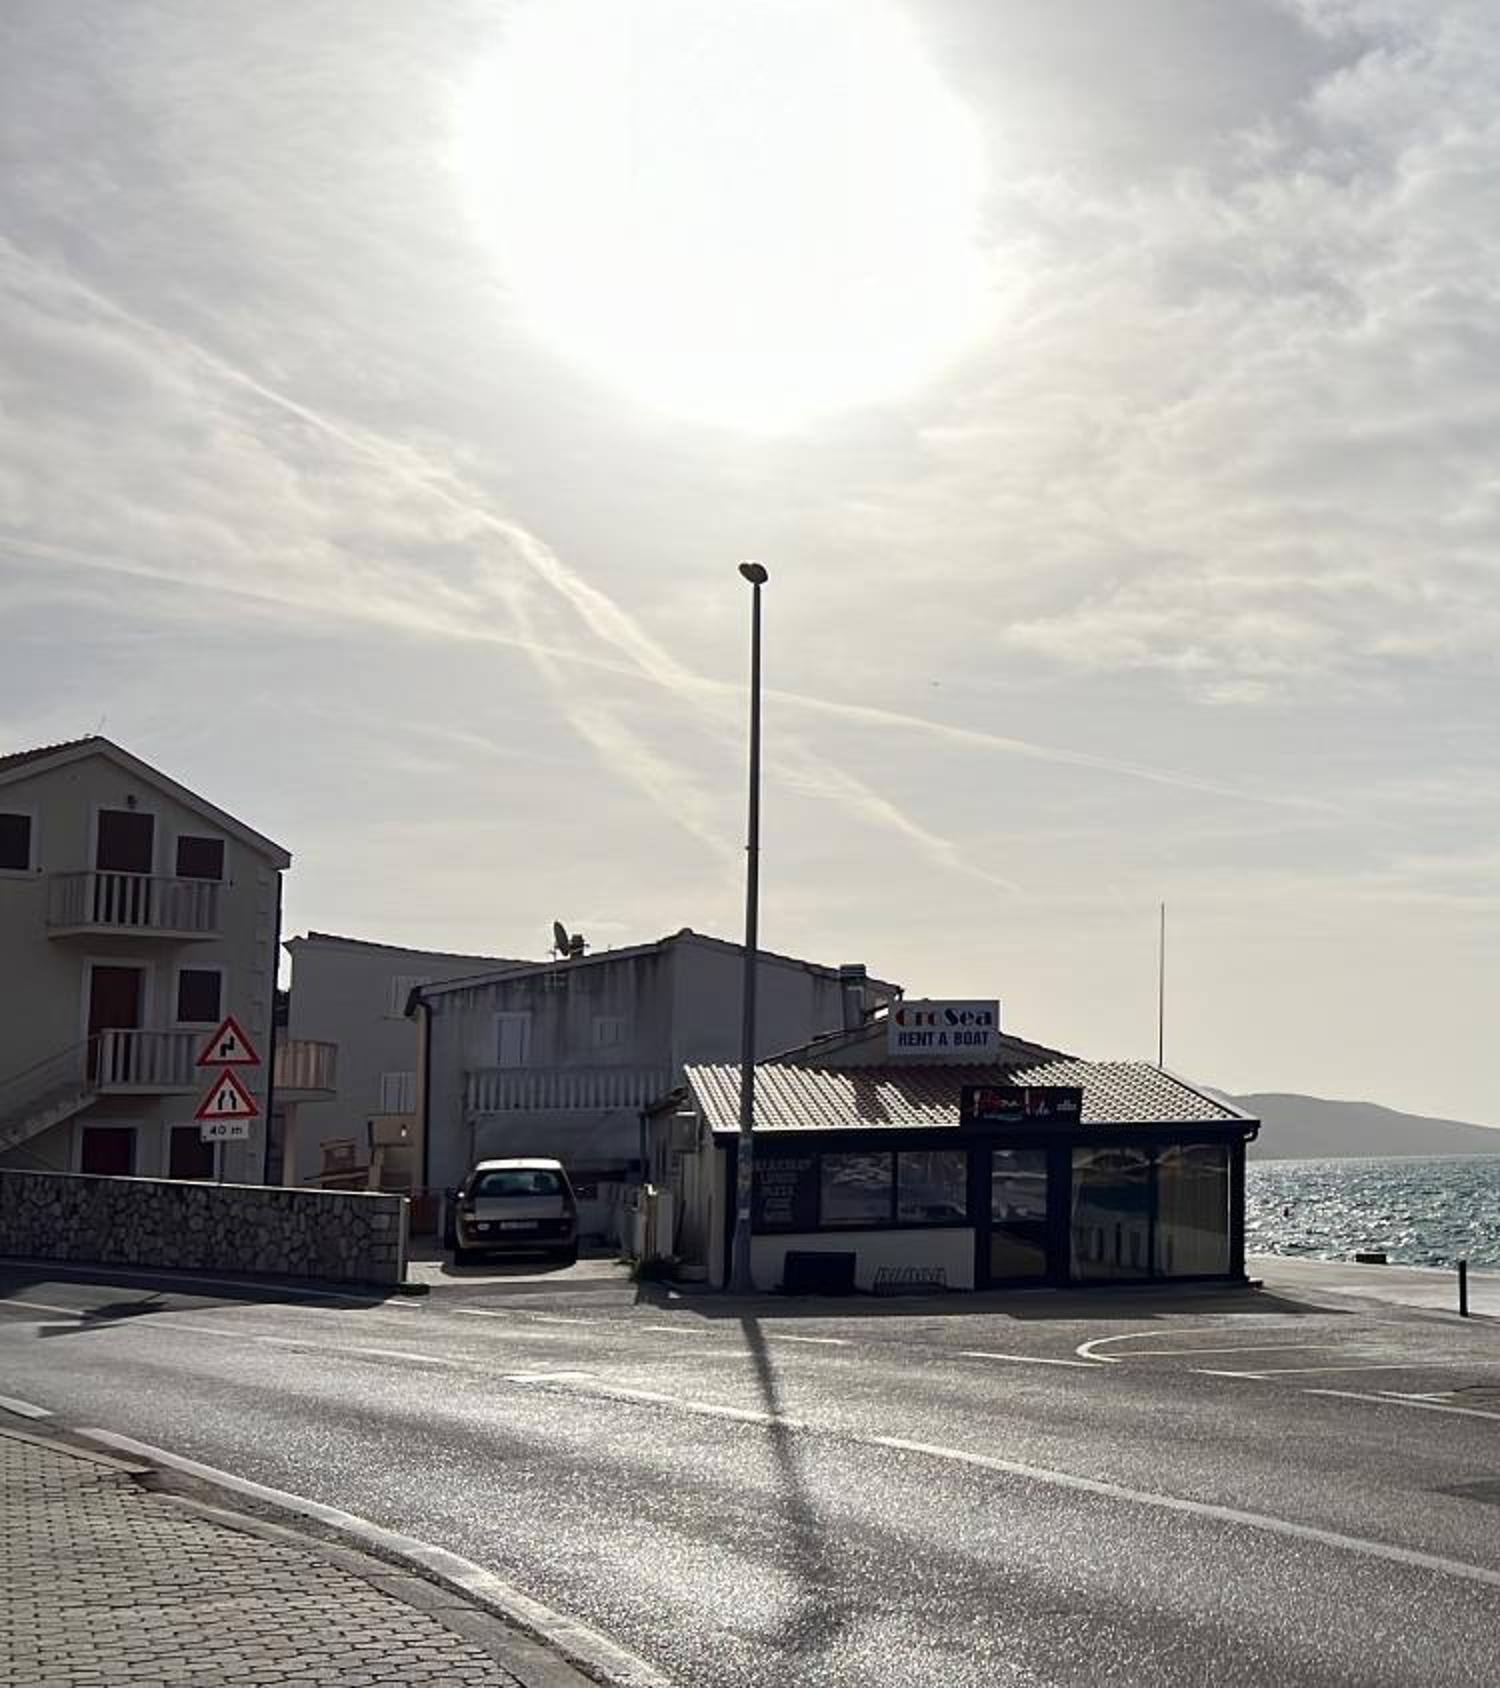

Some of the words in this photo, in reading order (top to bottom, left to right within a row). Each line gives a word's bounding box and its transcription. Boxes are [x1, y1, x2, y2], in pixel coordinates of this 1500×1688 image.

[896, 1008, 991, 1026] CroSea
[898, 1031, 934, 1046] RENT
[938, 1031, 949, 1046] A
[953, 1031, 990, 1046] BOAT
[210, 1125, 227, 1135] 40
